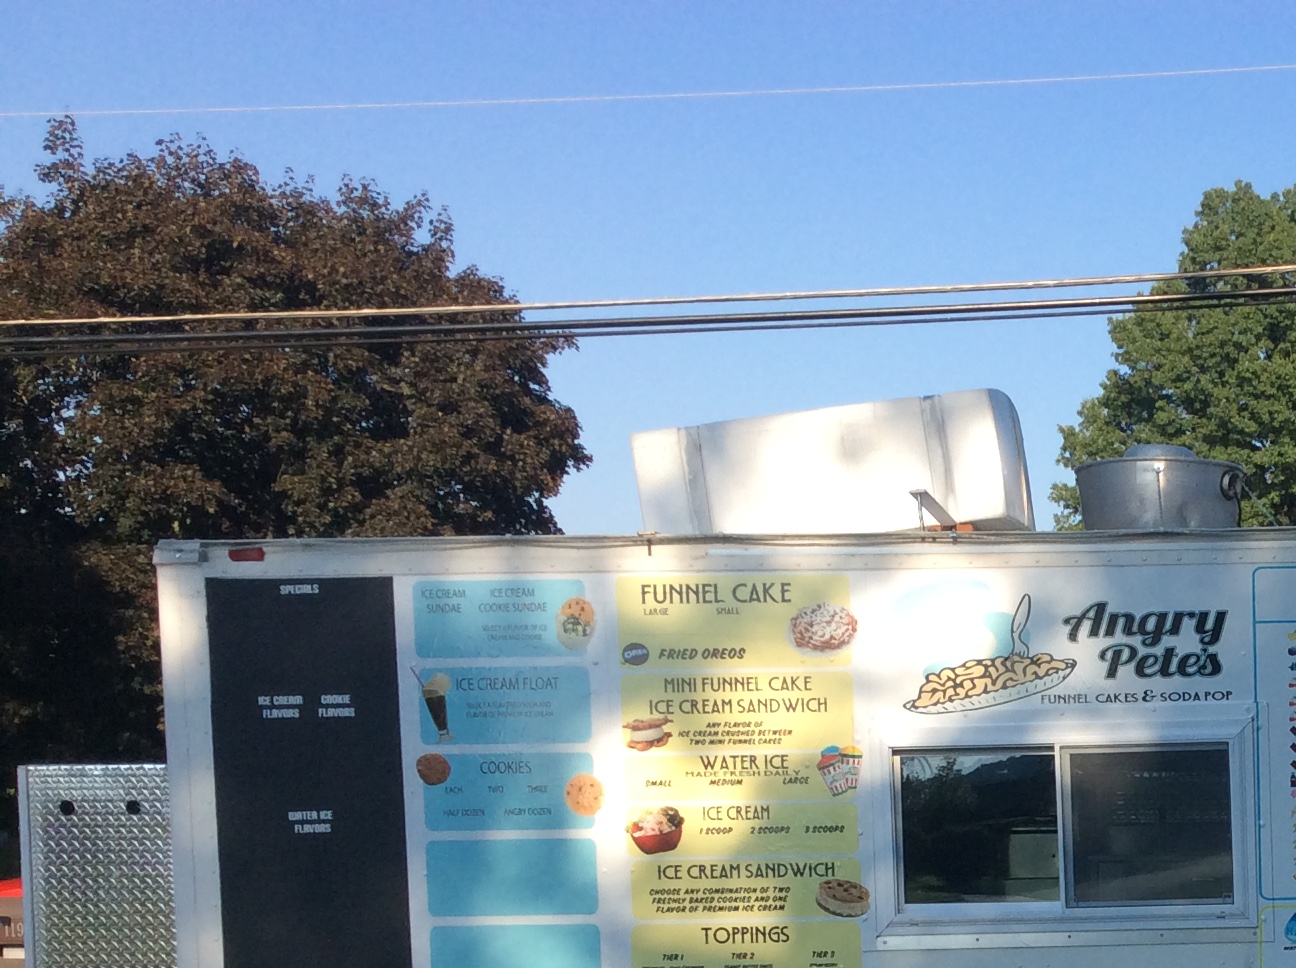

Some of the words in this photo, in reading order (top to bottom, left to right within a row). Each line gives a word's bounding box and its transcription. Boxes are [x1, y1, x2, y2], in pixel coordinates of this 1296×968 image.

[280, 584, 319, 595] SPECIALS
[421, 589, 433, 598] ICE
[436, 589, 466, 598] CREAM
[490, 588, 503, 597] ICE
[505, 588, 534, 597] CREAM
[641, 584, 724, 604] FUNNEL
[732, 583, 792, 603] CAKE
[427, 604, 461, 613] SUNDAE
[479, 603, 510, 612] COOKIE
[512, 602, 547, 612] SUNDAE
[643, 608, 669, 616] LARGE
[716, 607, 740, 615] SMALL
[1062, 600, 1229, 647] Angry
[658, 649, 698, 660] FRIED
[702, 648, 746, 659] OREOS
[1099, 643, 1224, 680] Pete's
[456, 678, 475, 691] ICE
[478, 677, 519, 690] CREAM
[523, 677, 559, 690] FLOAT
[664, 677, 697, 692] MINI
[702, 677, 763, 692] FUNNEL
[768, 676, 812, 691] CAKE
[258, 696, 271, 705] ICE
[273, 695, 303, 705] CREAM
[321, 694, 351, 704] COOKIE
[1041, 694, 1091, 704] FUNNEL
[1096, 693, 1139, 703] CAKES
[1142, 689, 1157, 703] &
[1160, 692, 1201, 702] SODA
[1204, 690, 1233, 701] POP
[649, 700, 674, 714] ICE
[679, 699, 733, 714] CREAM
[737, 698, 828, 713] SANDWICH
[262, 708, 299, 718] FLAVORS
[318, 707, 355, 717] FLAVORS
[480, 761, 532, 774] COOKIES
[700, 755, 759, 770] WATER
[765, 755, 789, 769] ICE
[288, 811, 317, 821] WATER
[320, 811, 333, 820] ICE
[703, 806, 722, 821] ICE
[727, 806, 770, 820] CREAM
[294, 823, 331, 833] FLAVORS
[705, 827, 733, 835] SCOOP
[758, 826, 790, 834] SCOOPS
[812, 825, 845, 833] SCOOPS
[658, 865, 682, 880] ICE
[687, 864, 740, 879] CREAM
[746, 862, 835, 879] SANDWICH
[649, 888, 681, 896] CHOOSE
[772, 886, 791, 894] TWO
[717, 896, 752, 904] COOKIES
[754, 895, 770, 903] AND
[757, 904, 785, 912] CREAM
[701, 926, 790, 944] TOPPINGS
[662, 954, 678, 962] TIER
